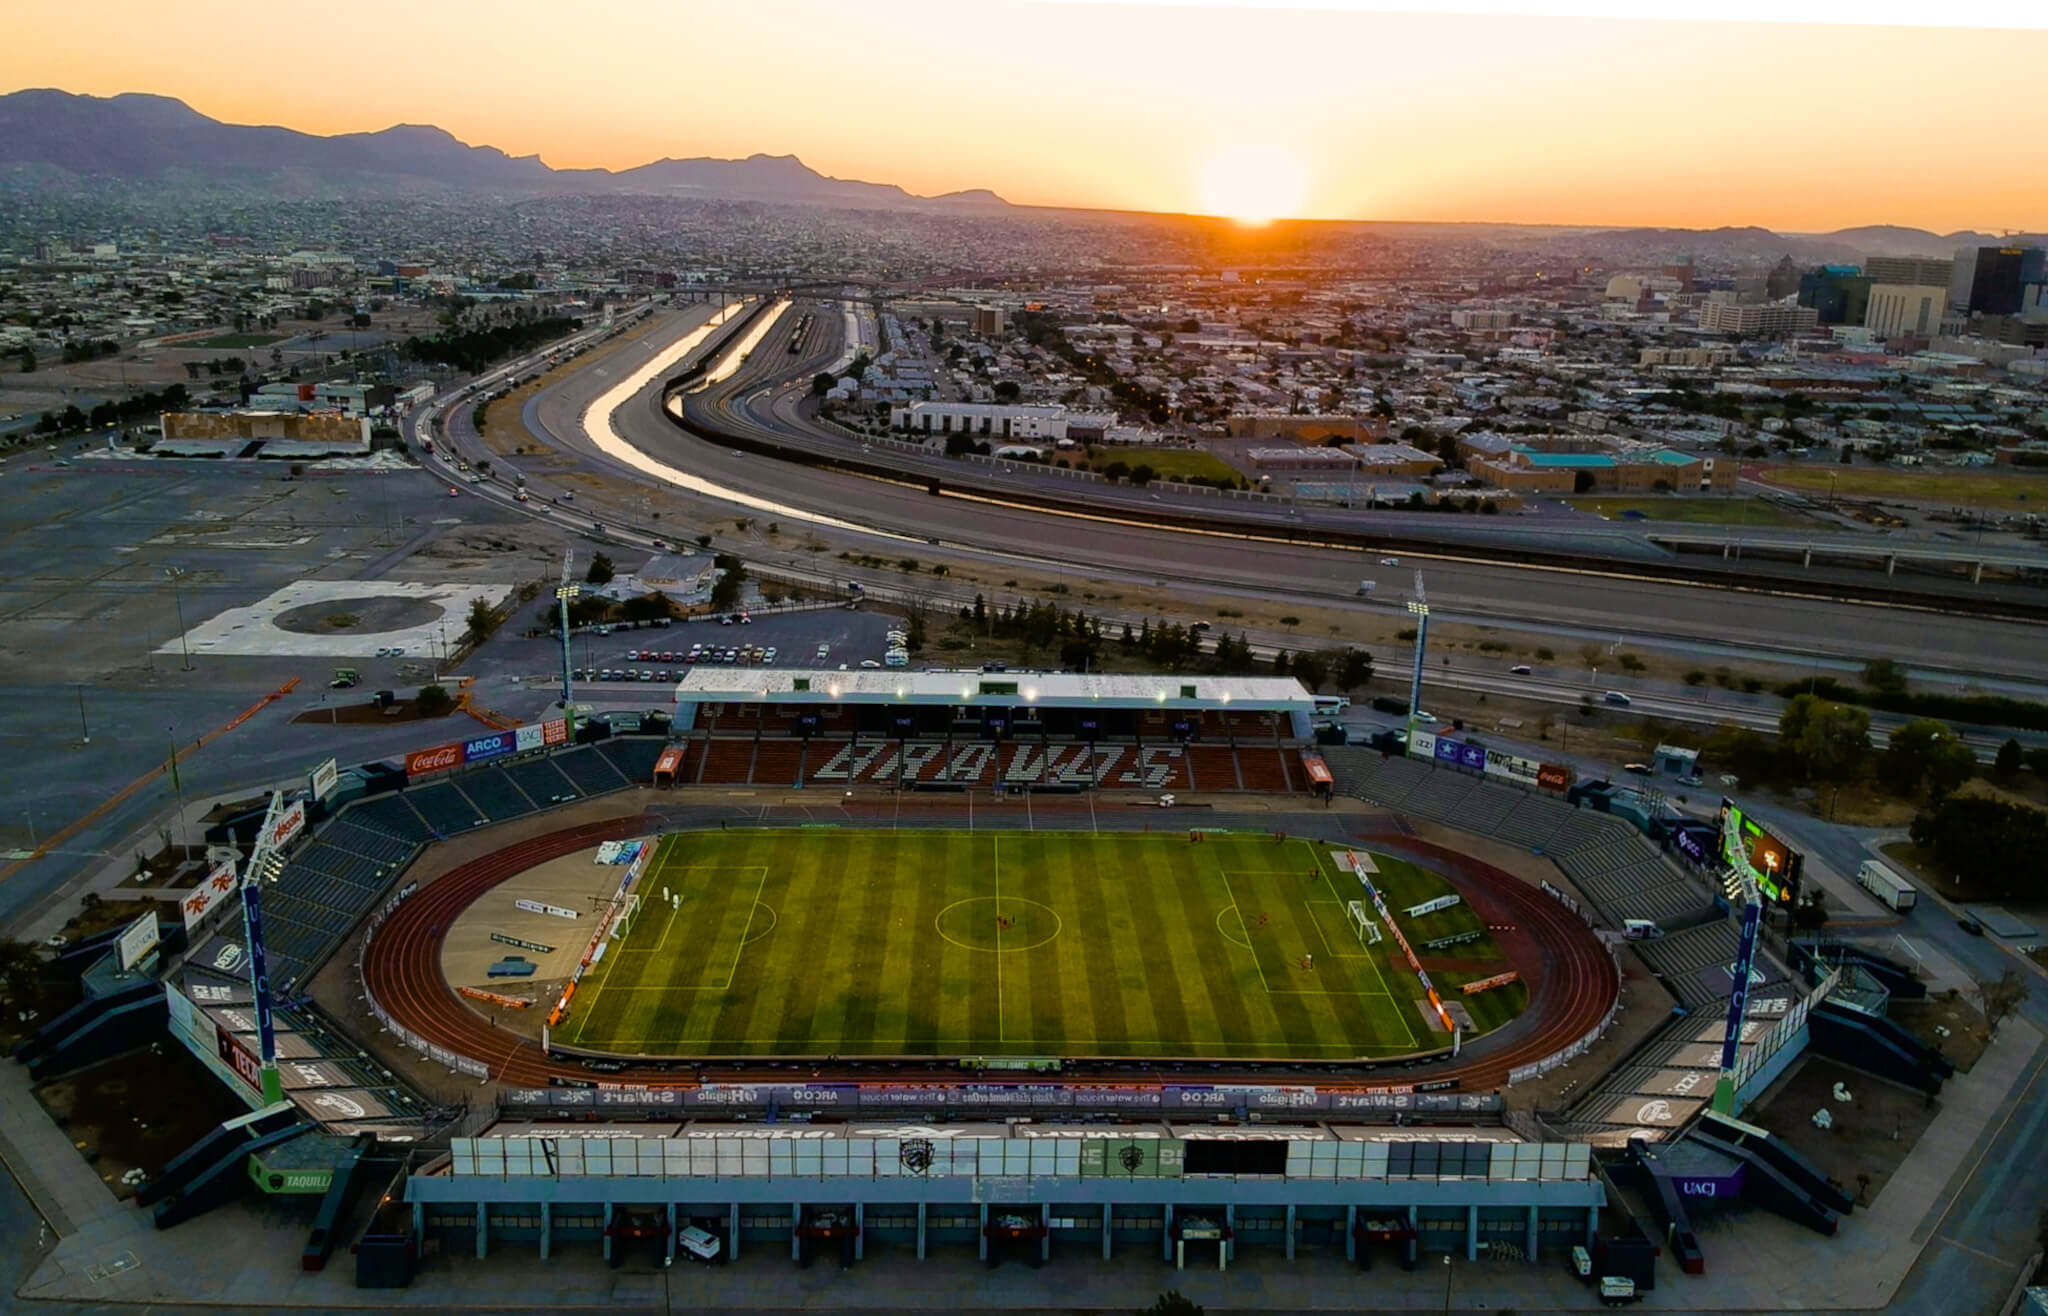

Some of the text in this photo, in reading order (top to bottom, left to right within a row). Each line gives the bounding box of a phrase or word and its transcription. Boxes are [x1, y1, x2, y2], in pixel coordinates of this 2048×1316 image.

[466, 738, 501, 755] ARCO
[813, 742, 1182, 788] BRAVOS
[232, 1044, 262, 1091] TECA
[1683, 1181, 1717, 1197] UACJ
